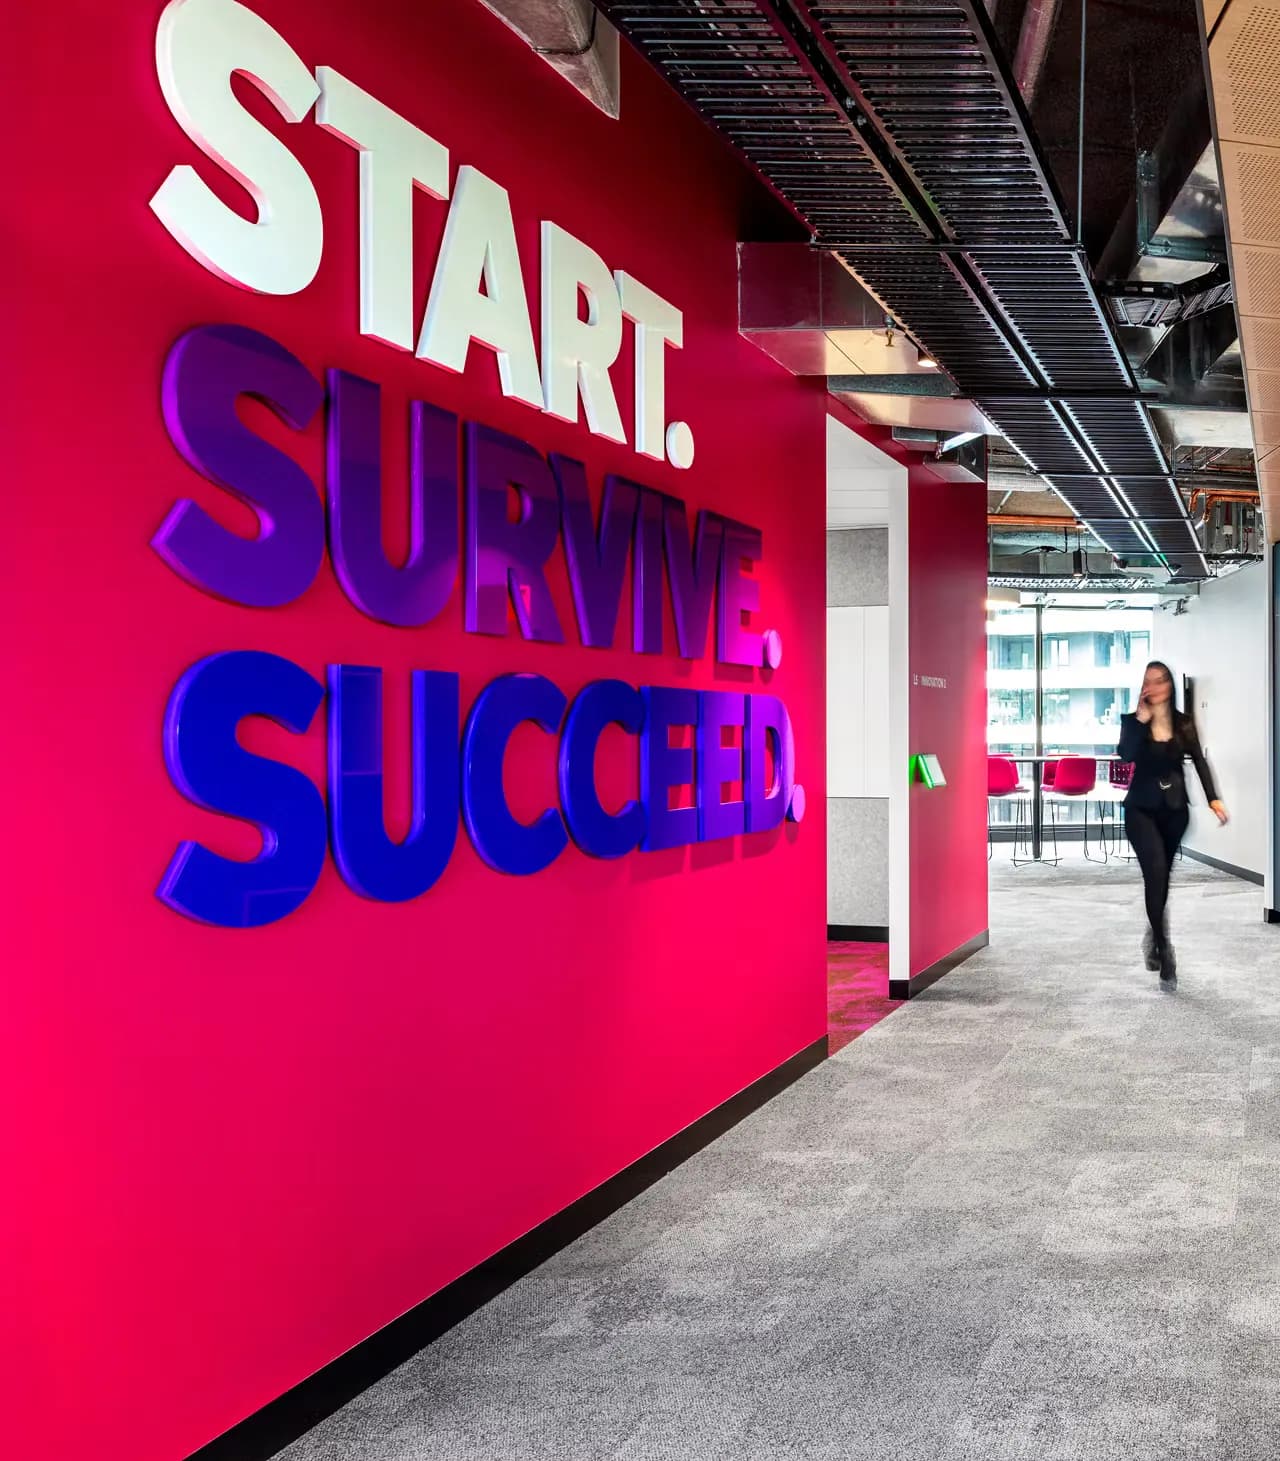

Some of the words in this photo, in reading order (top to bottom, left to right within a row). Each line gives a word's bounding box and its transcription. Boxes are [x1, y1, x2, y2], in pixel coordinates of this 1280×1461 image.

[149, 0, 695, 469] START.
[150, 323, 783, 671] SURVIVE.
[156, 650, 806, 928] SUCCEED.
